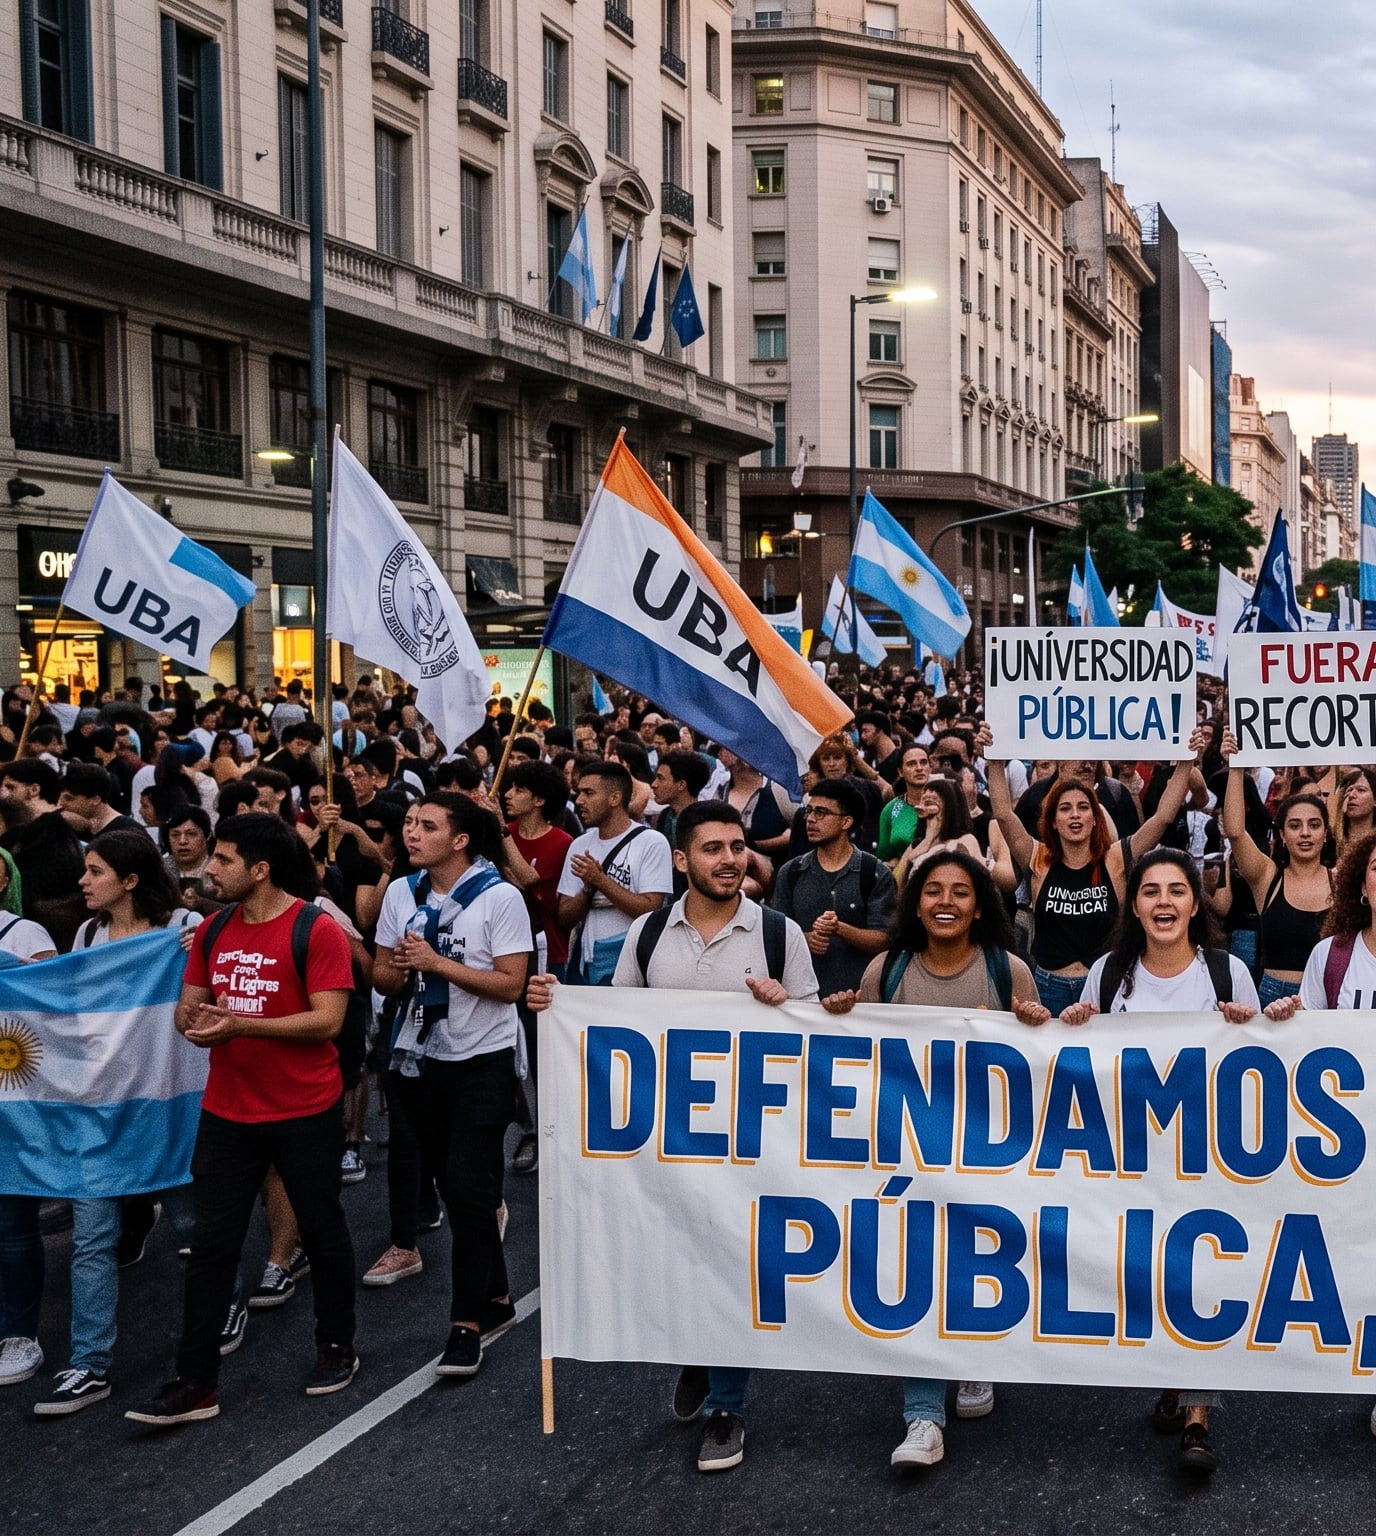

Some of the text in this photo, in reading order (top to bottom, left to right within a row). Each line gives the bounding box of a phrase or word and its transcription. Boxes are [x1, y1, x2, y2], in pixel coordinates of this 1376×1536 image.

[94, 566, 201, 657] UBA
[632, 547, 762, 699] UBA
[990, 631, 1194, 687] ¡UNÍVERSIDAD
[1018, 686, 1182, 745] PÚBLICA!
[581, 1025, 1366, 1187] DEFENDAMOS
